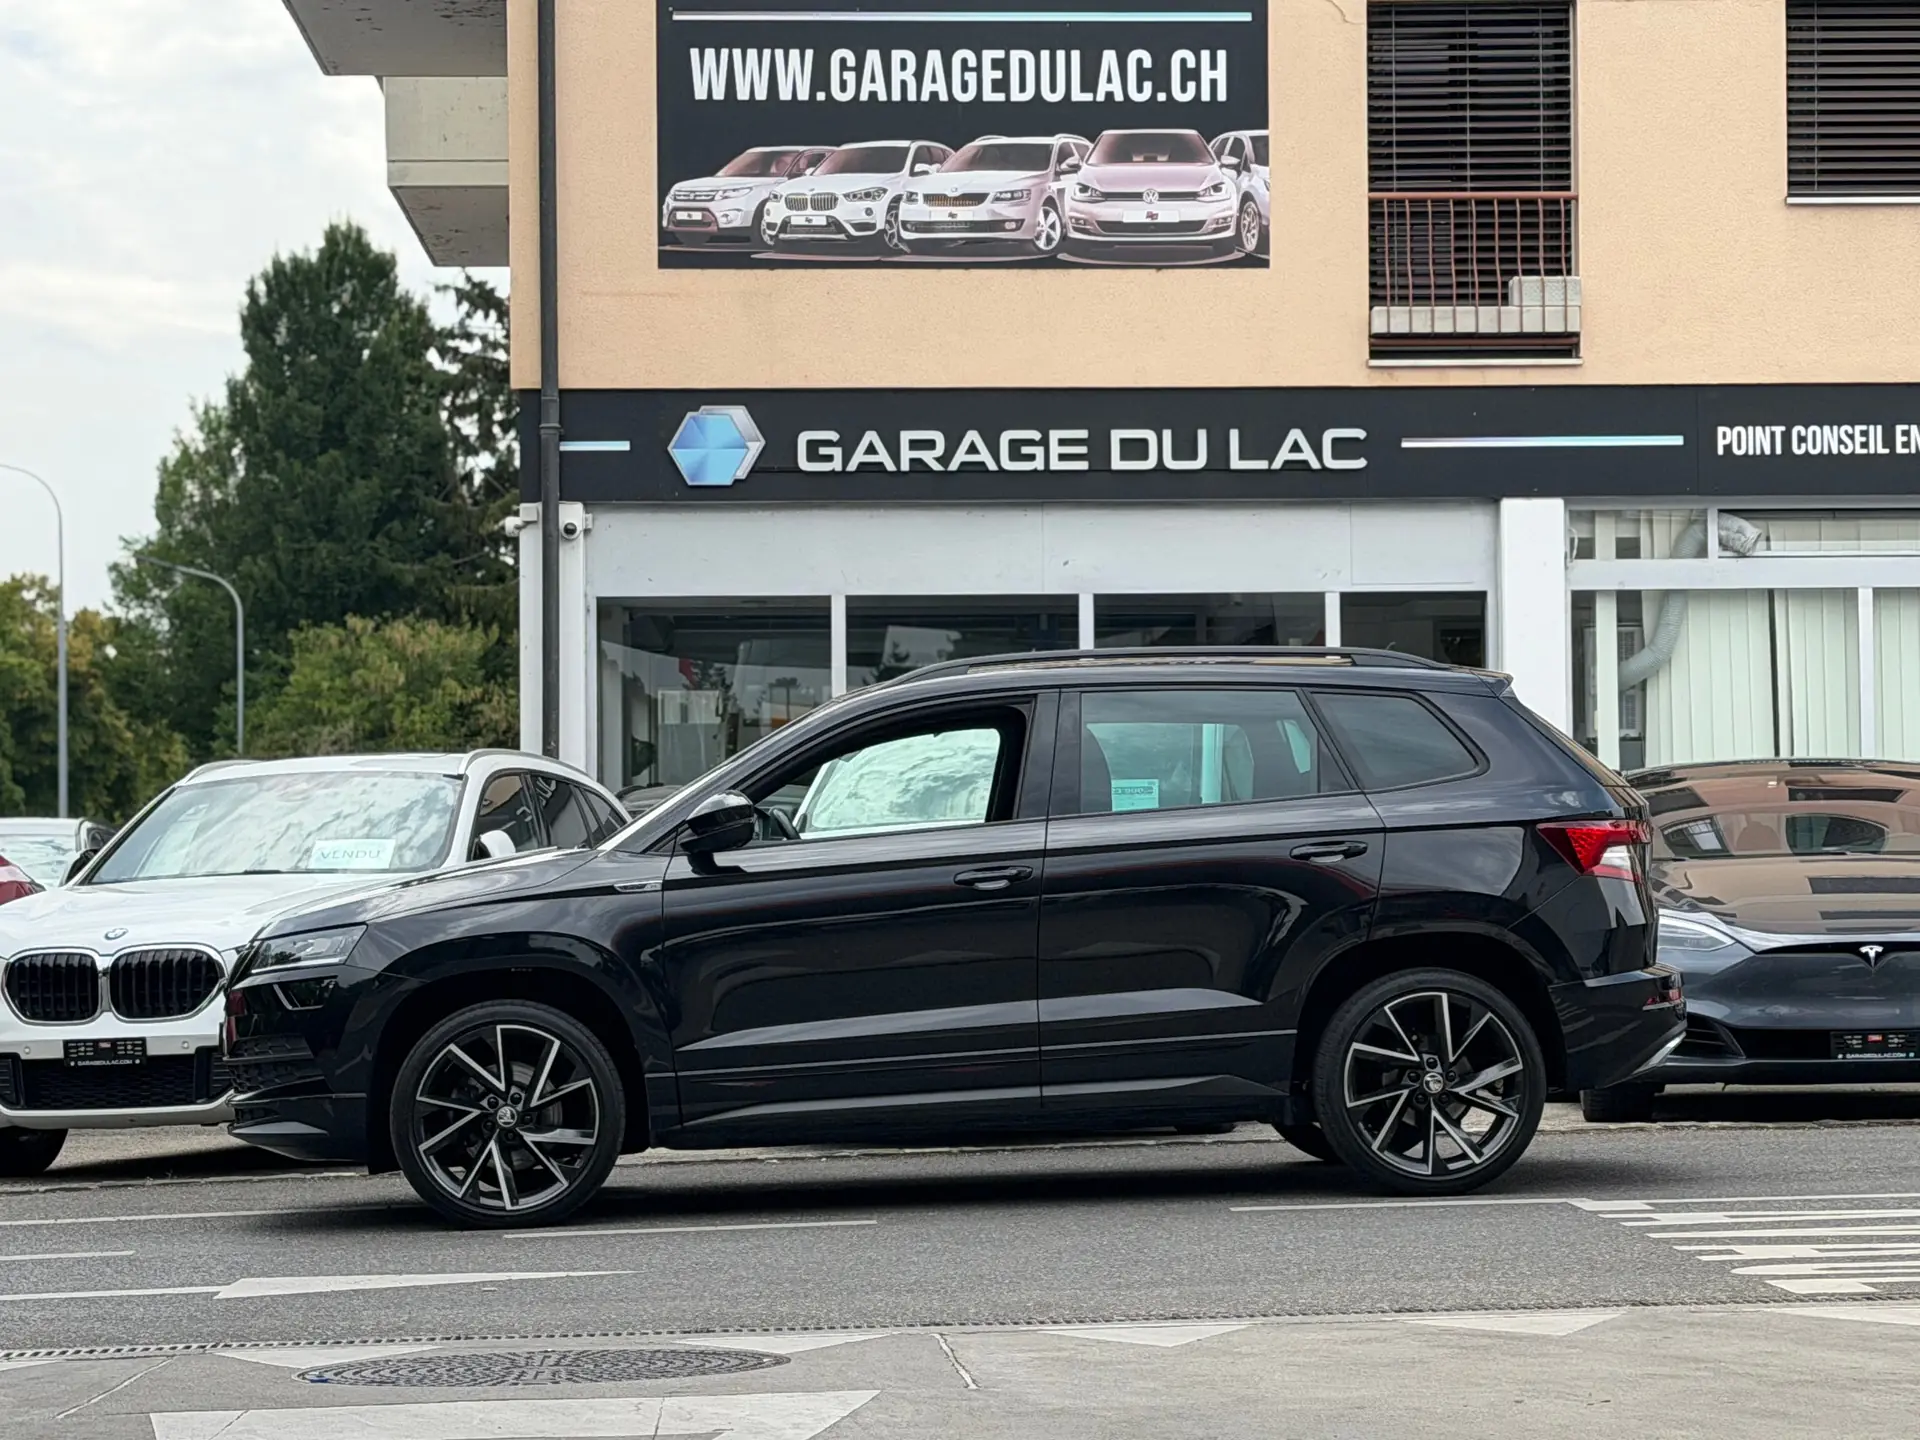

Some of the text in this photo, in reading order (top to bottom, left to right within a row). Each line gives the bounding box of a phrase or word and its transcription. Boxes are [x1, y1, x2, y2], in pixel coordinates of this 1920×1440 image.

[690, 48, 1227, 102] WWW.GARAGEDULAC.CH
[797, 428, 1368, 472] GARAGE DU LAC
[1717, 426, 1786, 455] POINT
[1792, 425, 1890, 454] CONSEIL
[321, 849, 381, 859] VENDU
